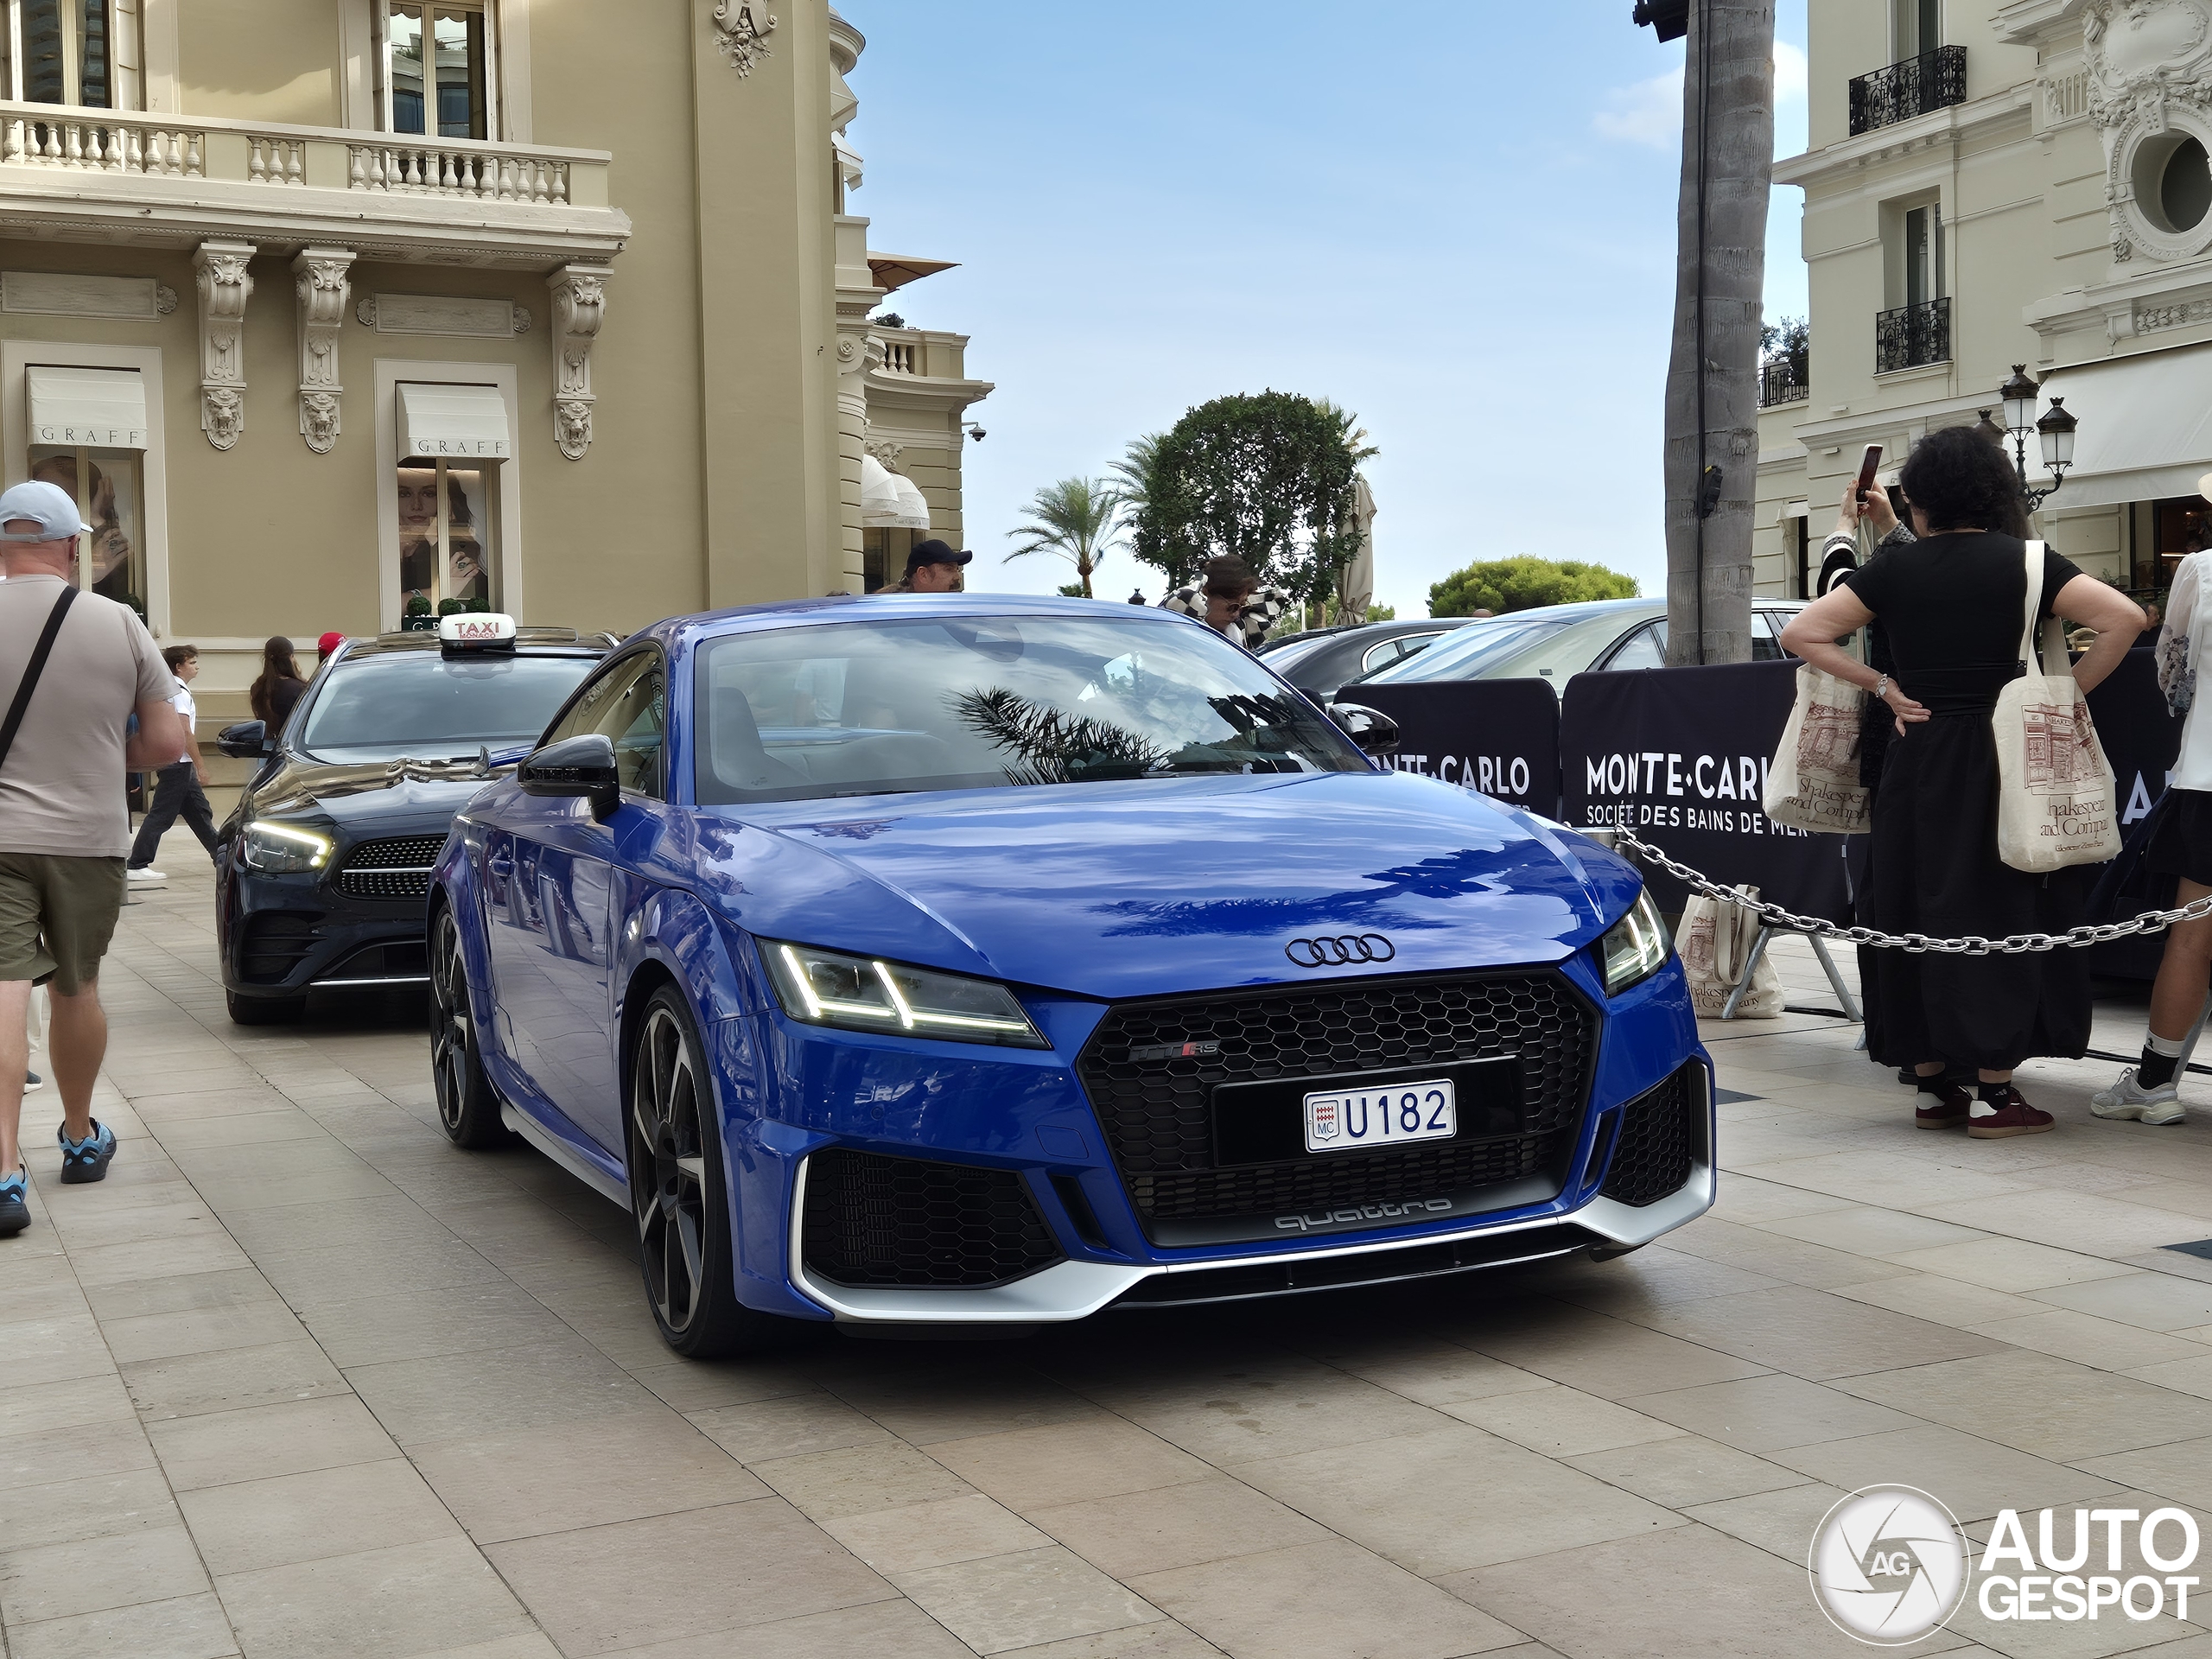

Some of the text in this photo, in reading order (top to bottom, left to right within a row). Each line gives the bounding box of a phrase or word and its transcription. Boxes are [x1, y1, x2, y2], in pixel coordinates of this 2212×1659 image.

[41, 426, 138, 444] GRAFF
[418, 439, 503, 454] GRAFF
[454, 621, 499, 633] TAXI
[1786, 796, 1811, 810] and
[1640, 804, 1681, 827] DES
[1687, 807, 1734, 831] BAINS
[1740, 811, 1764, 834] DE
[2040, 817, 2061, 836] and
[1317, 1090, 1447, 1138] MC U182
[1274, 1198, 1452, 1231] quattro
